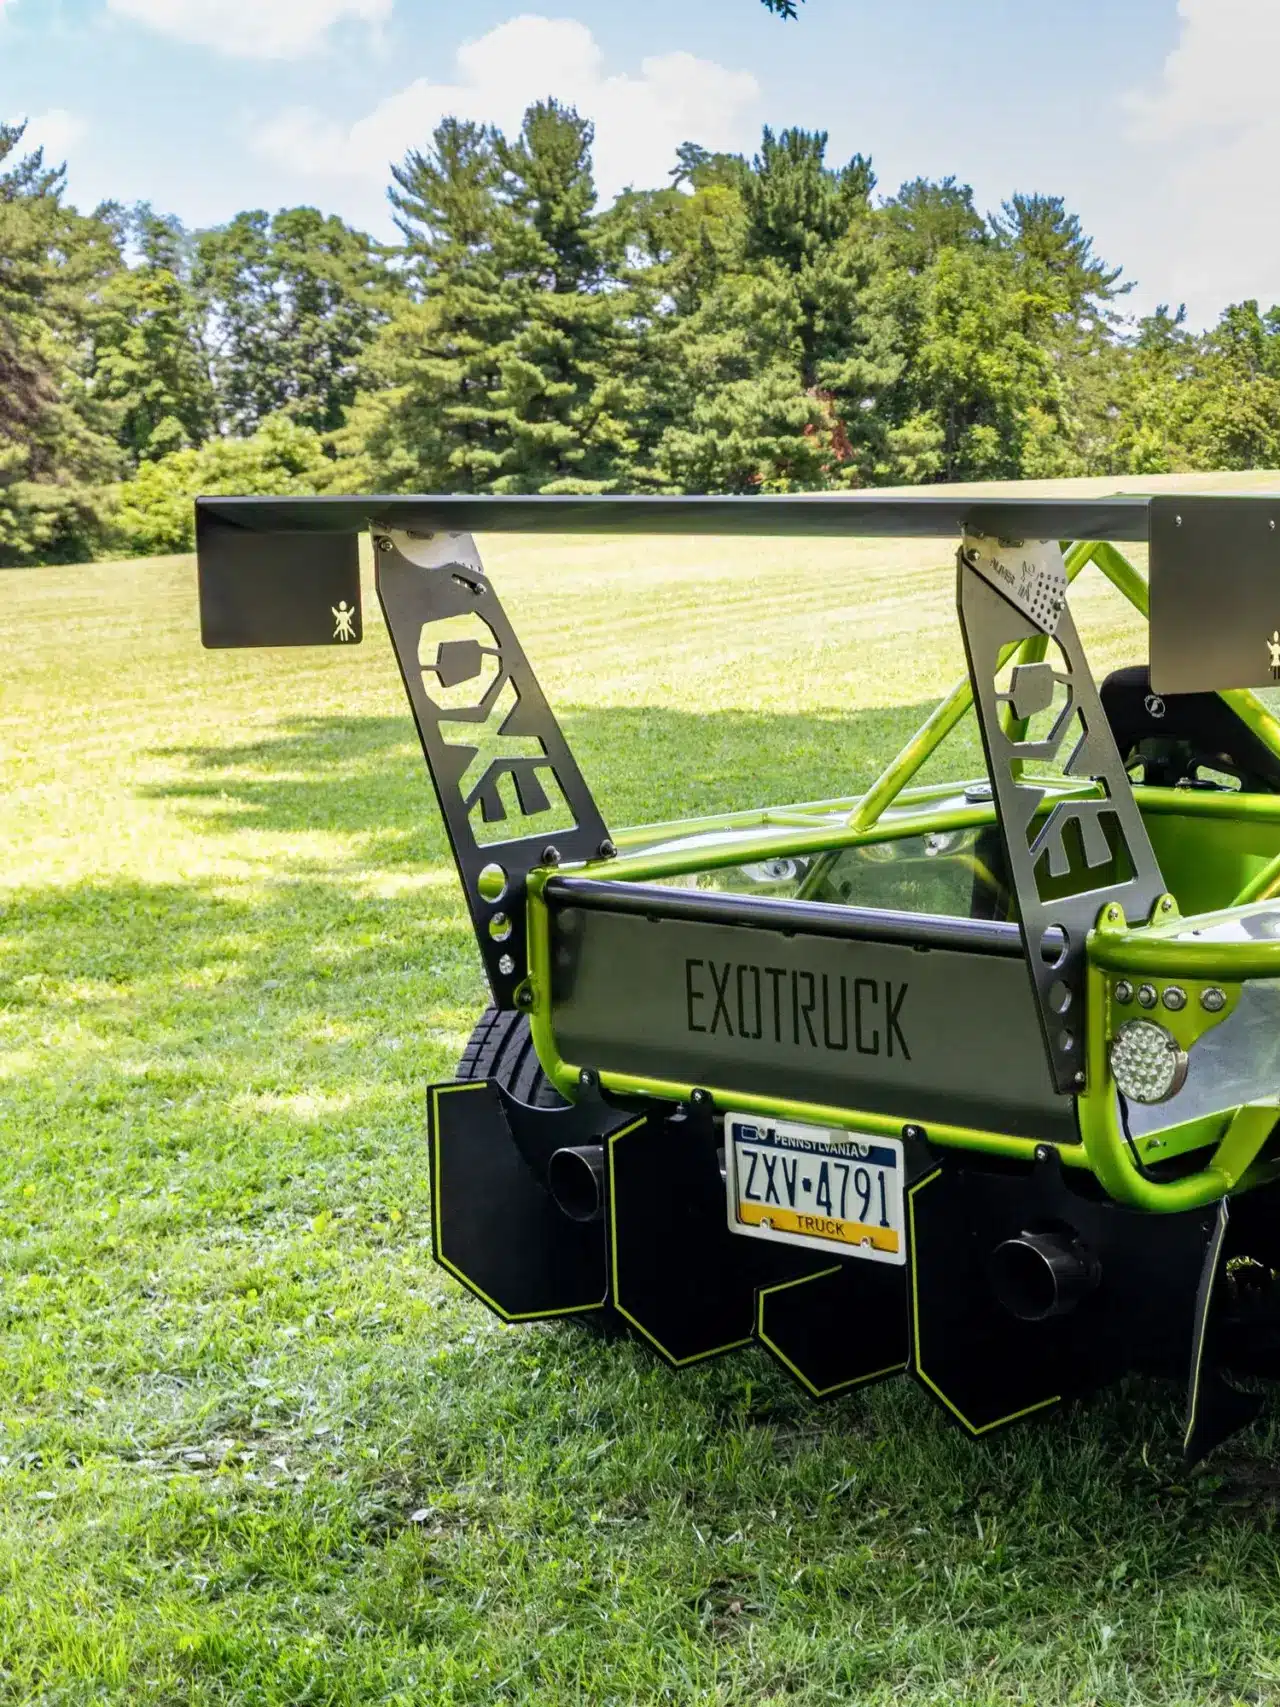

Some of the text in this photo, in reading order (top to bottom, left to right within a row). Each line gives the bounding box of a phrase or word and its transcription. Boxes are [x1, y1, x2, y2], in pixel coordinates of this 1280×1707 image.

[417, 611, 579, 848] EXO
[993, 634, 1139, 906] EXO
[685, 958, 912, 1061] EXOTRUCK
[774, 1133, 859, 1159] PENNSYLVANIA
[796, 1215, 846, 1237] TRUCK
